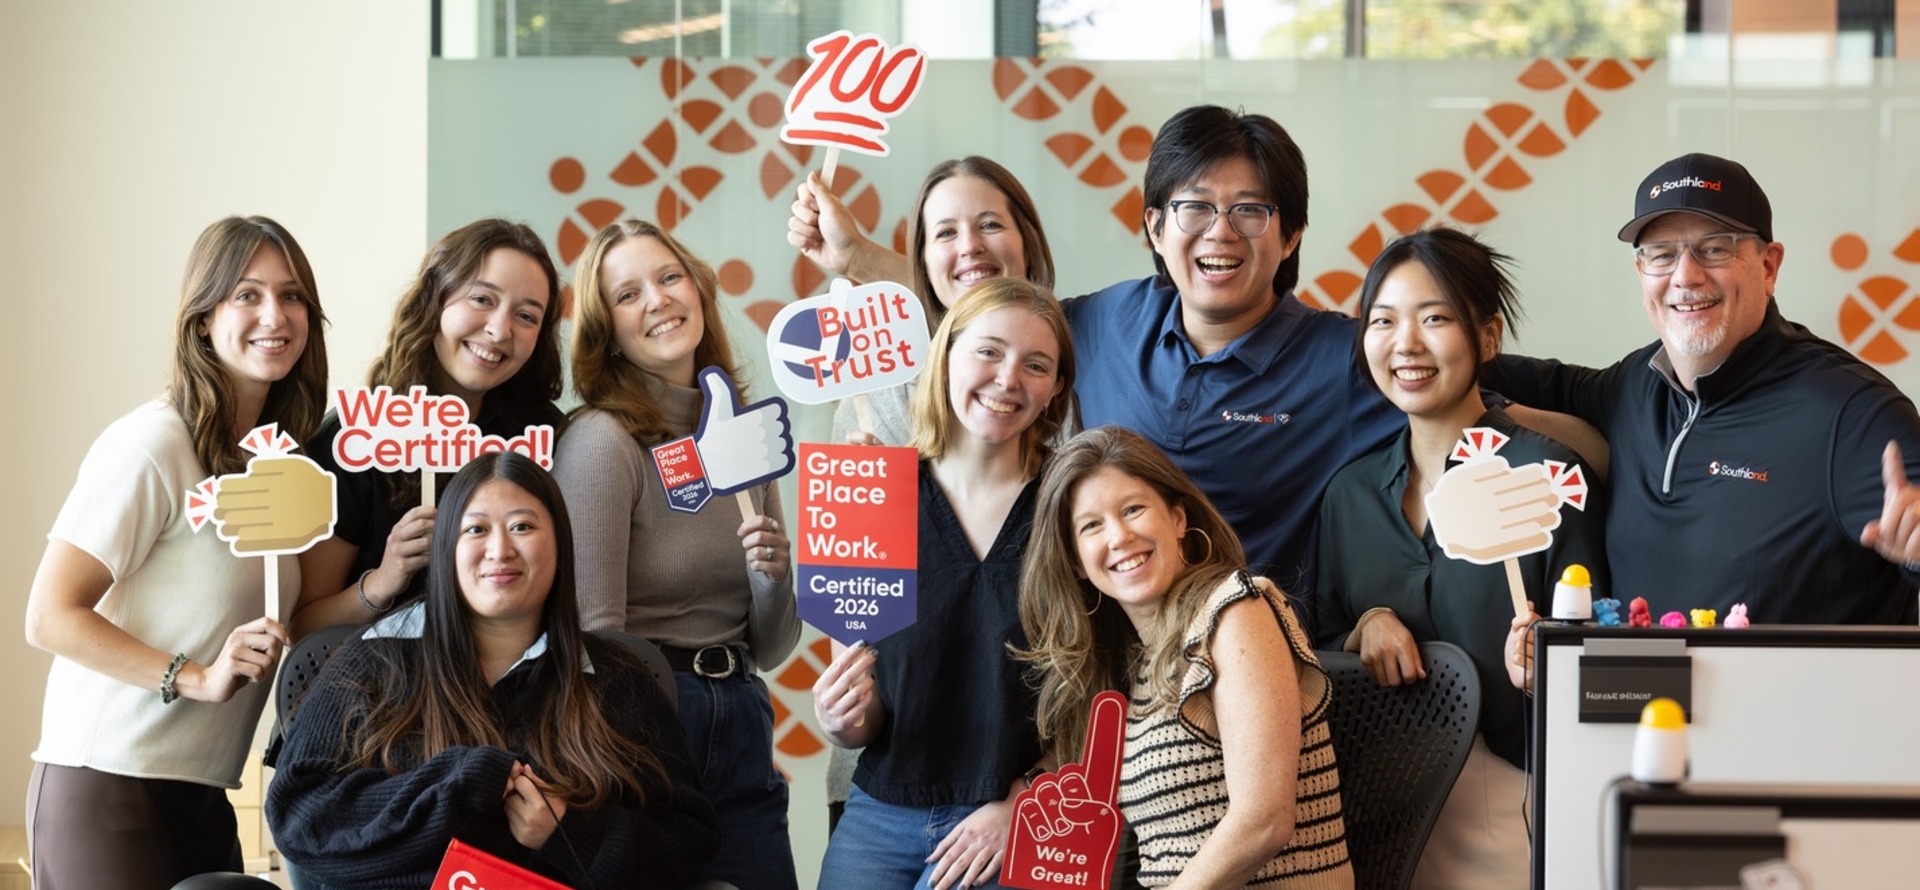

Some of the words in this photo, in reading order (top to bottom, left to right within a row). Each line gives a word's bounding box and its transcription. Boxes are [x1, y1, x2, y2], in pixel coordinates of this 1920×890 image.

[791, 35, 924, 114] 100
[817, 293, 910, 339] Built
[852, 328, 893, 352] on
[804, 340, 915, 388] Trust
[337, 389, 465, 428] We're
[657, 445, 685, 458] Great
[660, 455, 687, 467] Place
[806, 452, 887, 478] Great
[672, 481, 704, 496] Certified
[682, 492, 698, 500] 2026
[808, 478, 886, 505] Place
[806, 506, 837, 529] To
[809, 574, 904, 597] Certified
[834, 598, 879, 616] 2026
[845, 620, 867, 630] USA
[1035, 844, 1088, 865] We're
[1030, 865, 1089, 886] Great!
